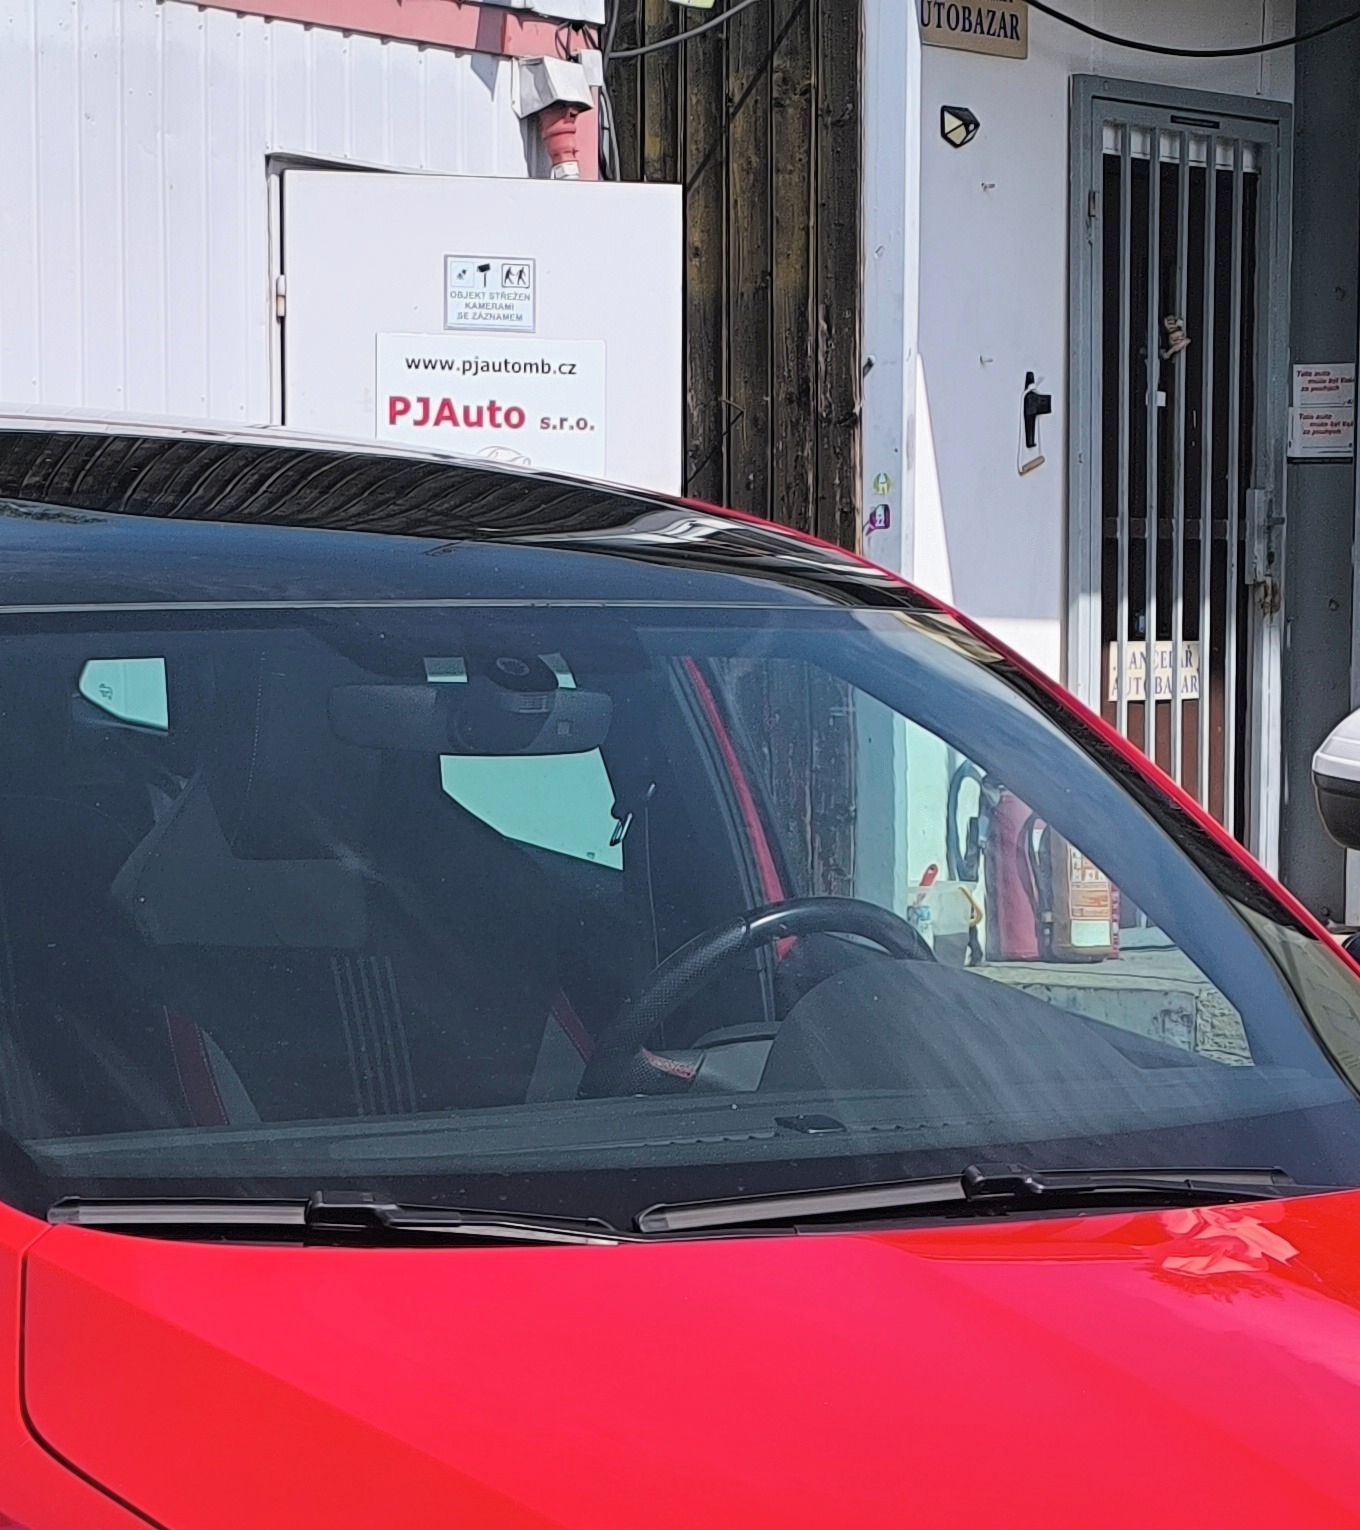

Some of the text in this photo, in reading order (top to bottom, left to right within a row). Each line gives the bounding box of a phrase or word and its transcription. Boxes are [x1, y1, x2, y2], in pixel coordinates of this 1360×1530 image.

[920, 0, 1020, 41] UTOBAZAR
[449, 290, 531, 301] OBJEKT STŘEŽEN
[464, 301, 515, 311] KAMERAMI
[471, 311, 523, 321] ZÁZNAMEM
[405, 356, 577, 376] www.pjautomb.cz
[388, 395, 595, 431] PJAuto s.r.o.
